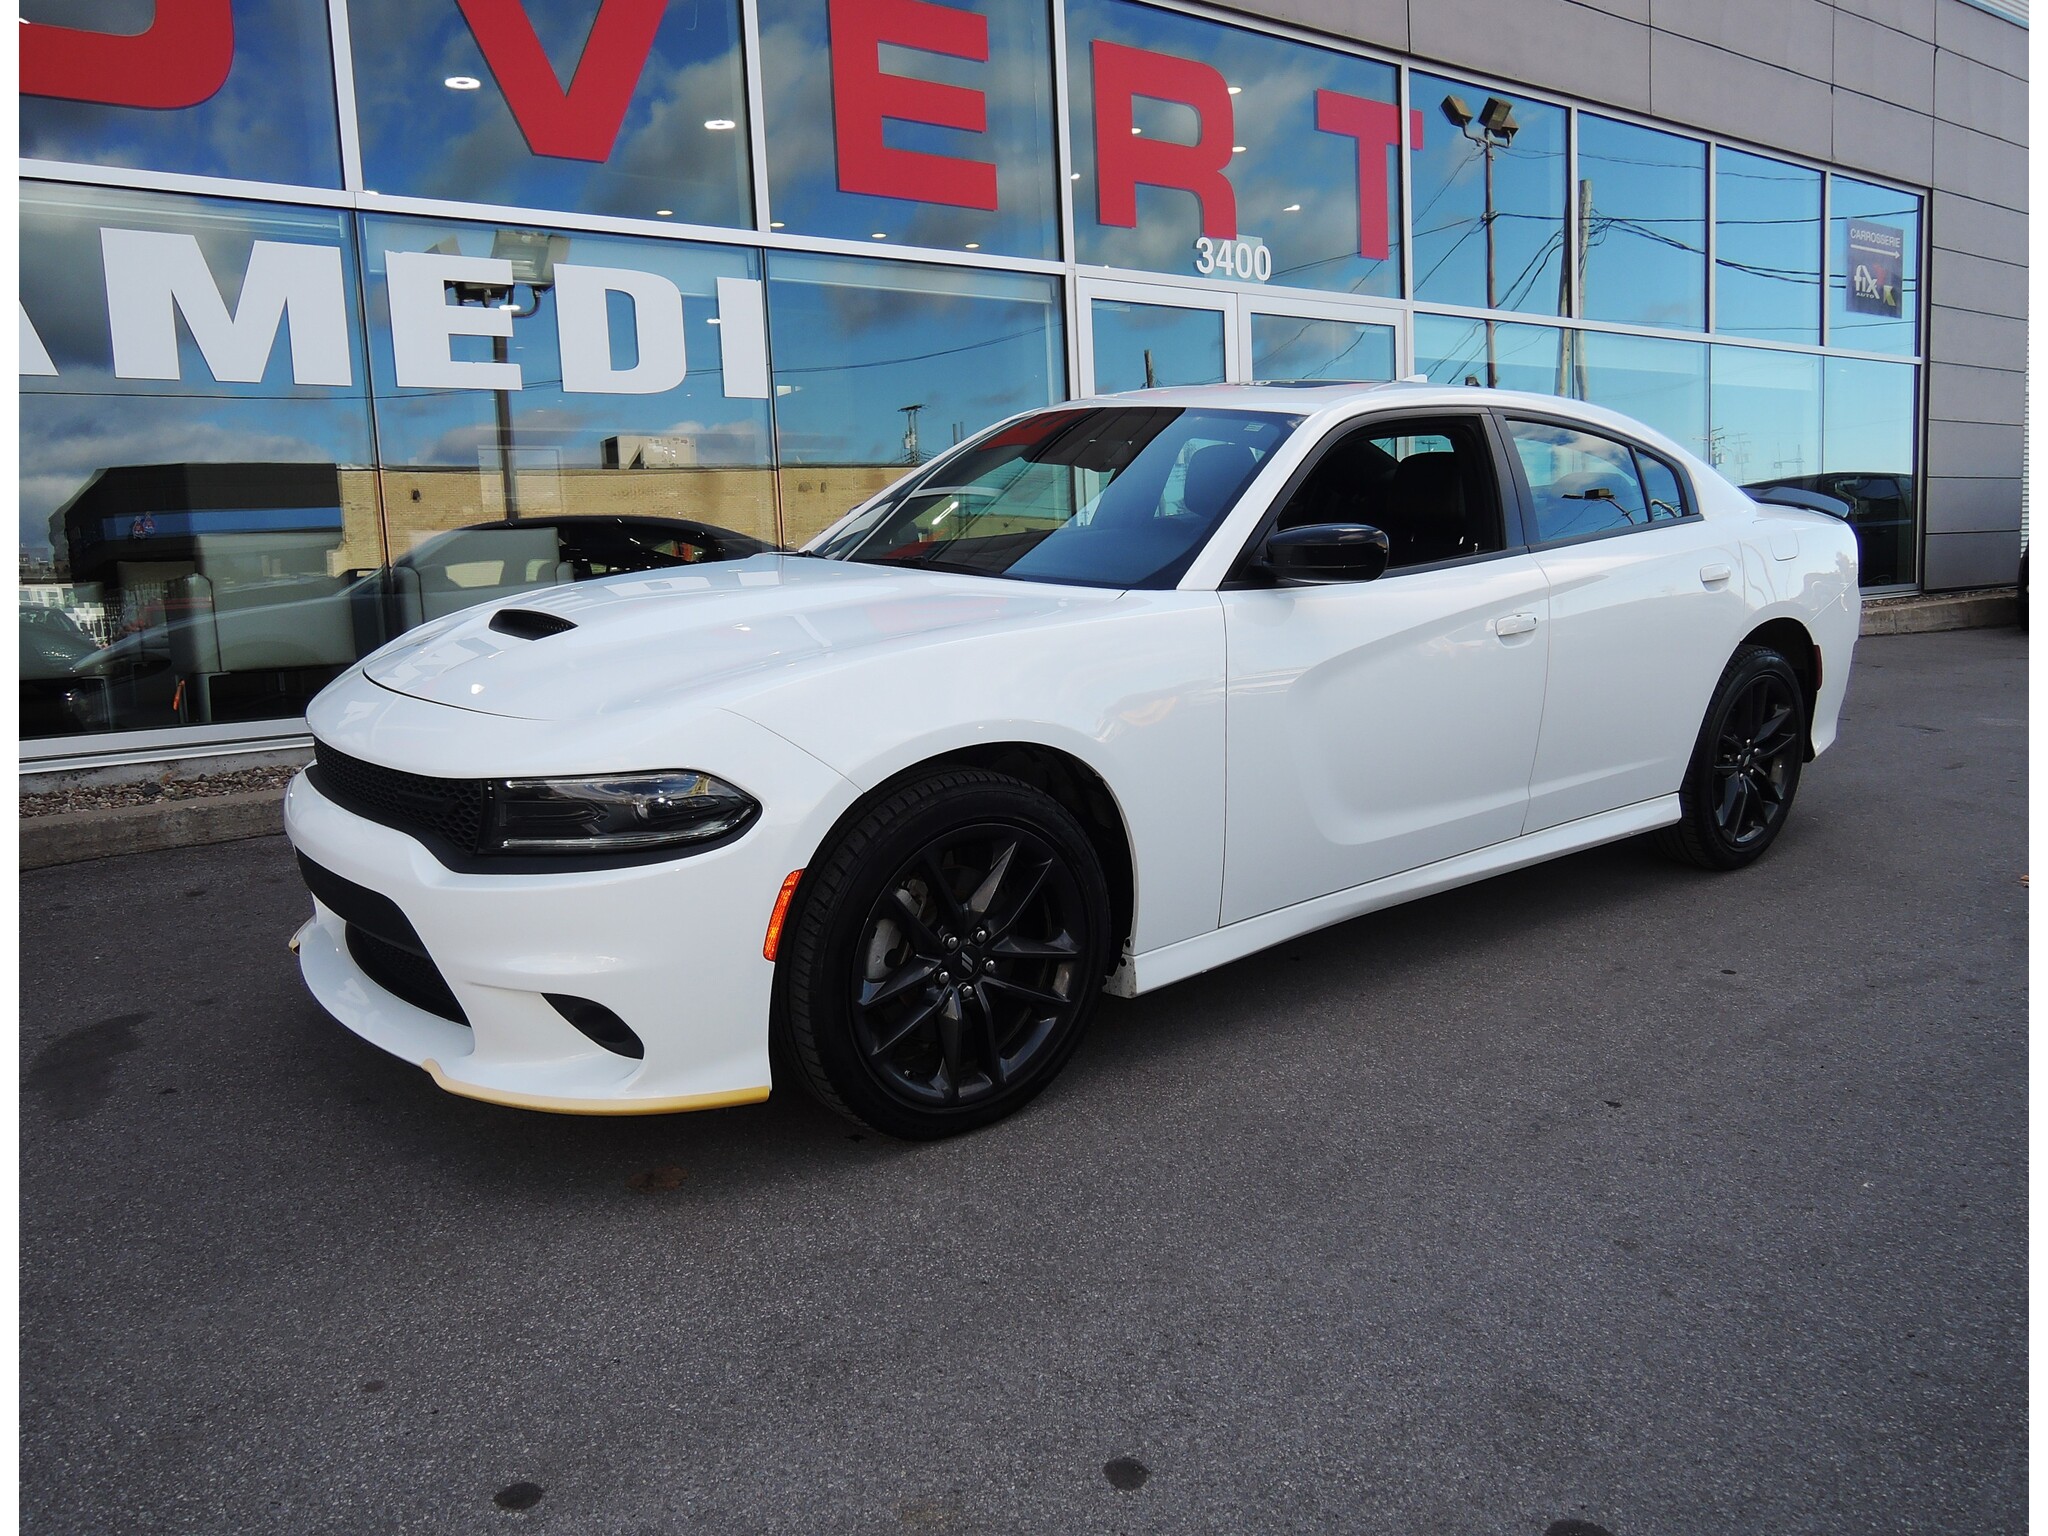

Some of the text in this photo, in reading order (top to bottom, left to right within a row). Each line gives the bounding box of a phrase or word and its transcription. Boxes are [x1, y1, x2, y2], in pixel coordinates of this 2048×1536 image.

[1850, 228, 1901, 248] CARROSSERIE
[1196, 236, 1271, 281] 3400
[1856, 291, 1875, 299] AUTO
[19, 227, 769, 399] MEDI
